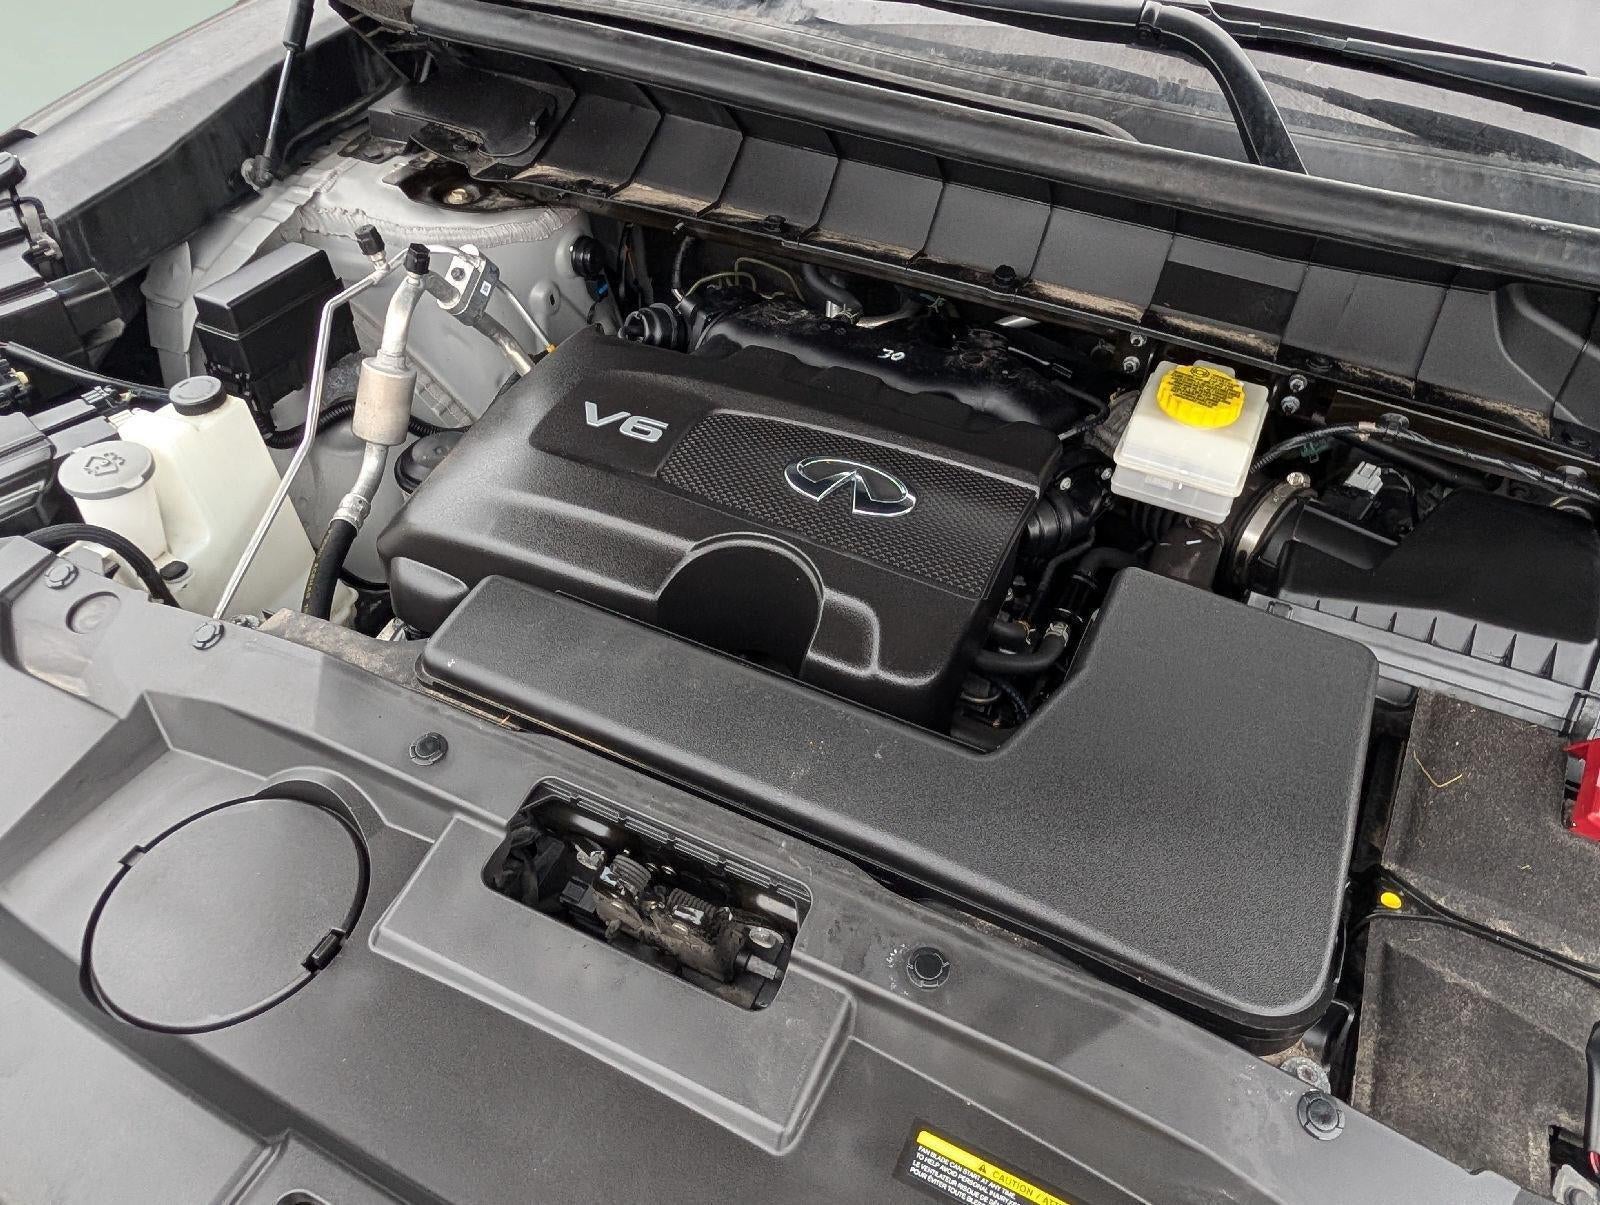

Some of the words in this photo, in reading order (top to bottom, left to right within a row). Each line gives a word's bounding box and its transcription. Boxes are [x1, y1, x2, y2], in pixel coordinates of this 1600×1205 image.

[585, 401, 669, 443] V6
[910, 1166, 928, 1180] POUR
[927, 1175, 947, 1190] ÉVITER
[947, 1185, 966, 1200] TOUTE
[912, 1160, 920, 1168] LE
[921, 1164, 957, 1187] VENTILATEUR
[957, 1183, 980, 1198] RISQUE
[916, 1152, 924, 1160] TO
[924, 1157, 940, 1167] HELP
[939, 1165, 957, 1177] AVOID
[958, 1174, 989, 1194] PERSONAL
[918, 1145, 931, 1156] FAN
[930, 1151, 949, 1165] BLADE
[949, 1161, 963, 1172] CAN
[962, 1168, 981, 1181] START
[980, 1175, 989, 1184] AT
[988, 1180, 1001, 1191] ANY
[992, 1170, 1033, 1197] CAUTION
